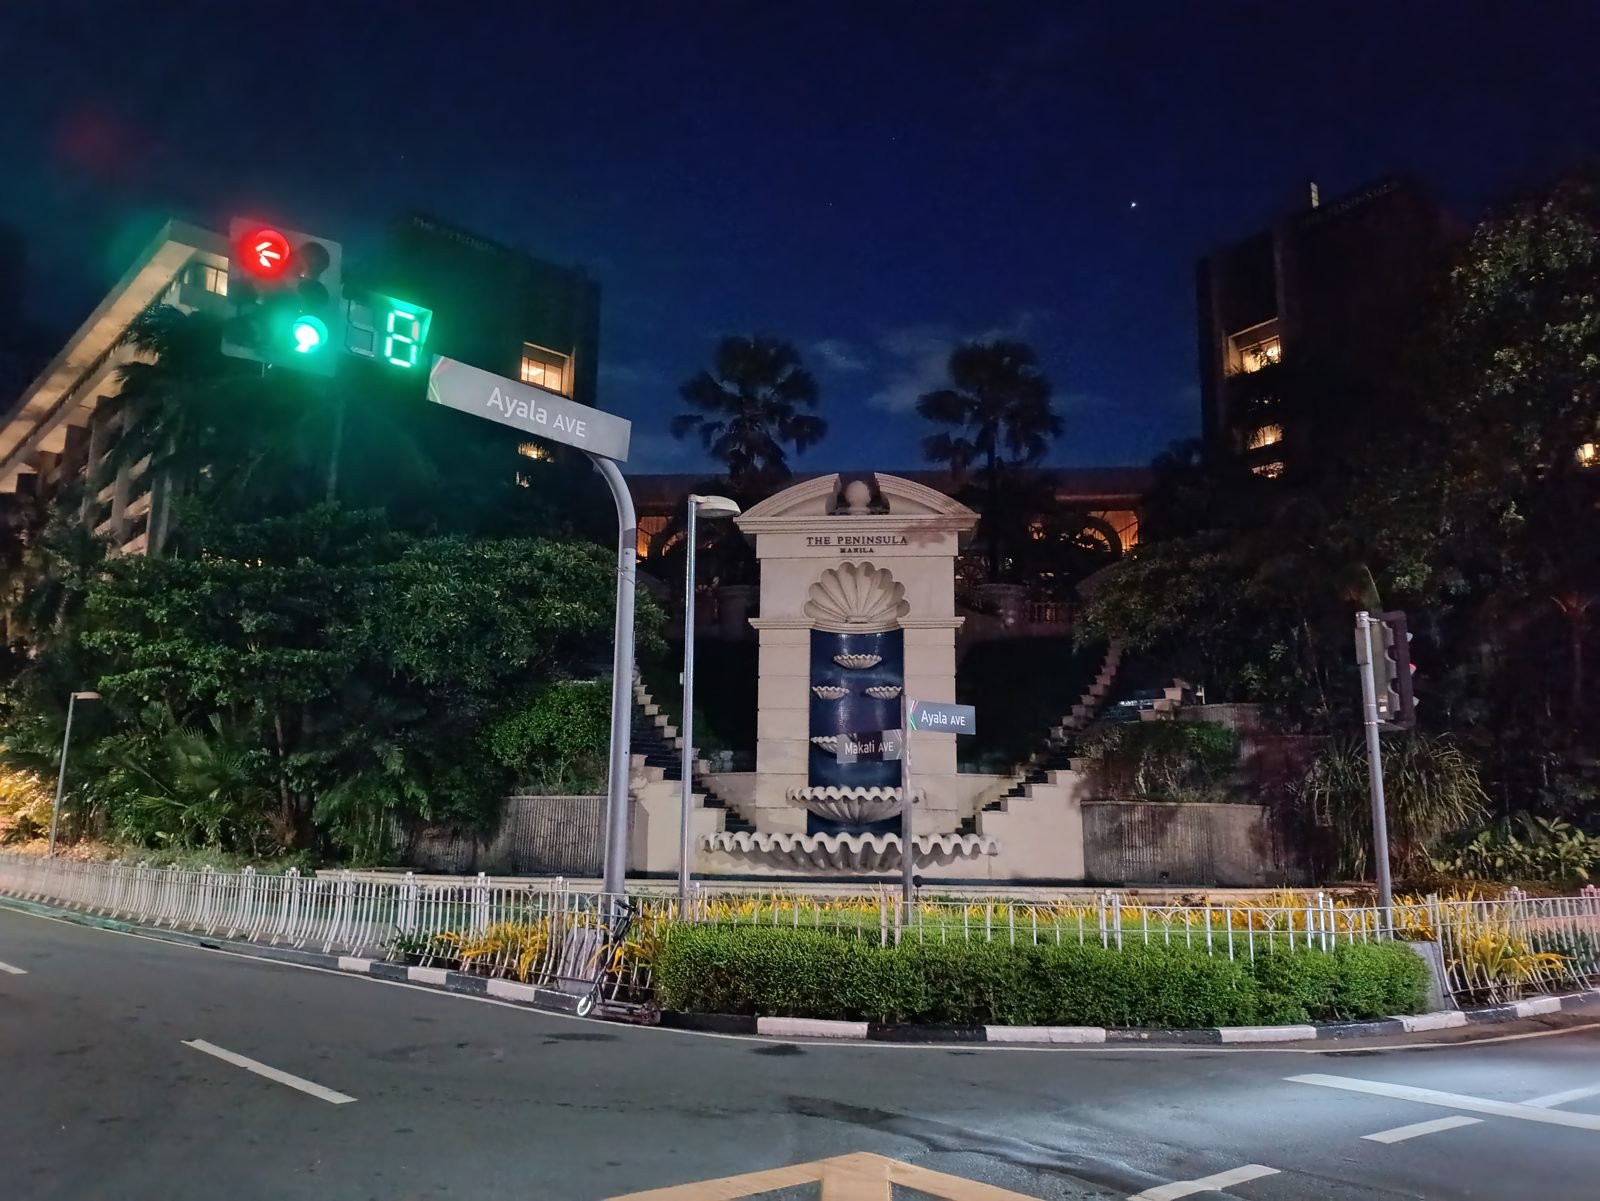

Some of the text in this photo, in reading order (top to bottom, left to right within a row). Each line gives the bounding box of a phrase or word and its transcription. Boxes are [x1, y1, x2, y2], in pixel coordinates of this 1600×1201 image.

[486, 387, 586, 437] Ayala AVE
[805, 535, 908, 545] THE PENINSULA
[921, 710, 966, 727] Ayala AVE
[844, 740, 894, 755] Makati AVE
